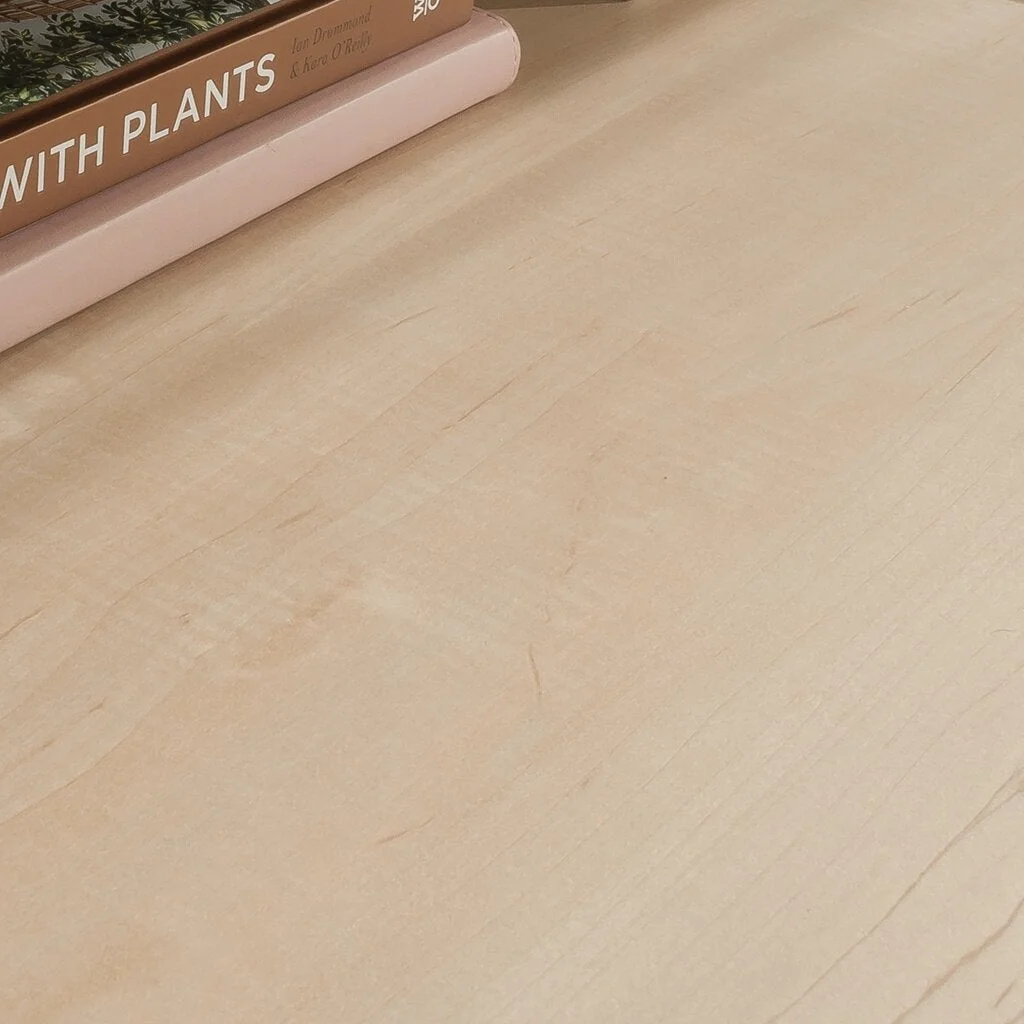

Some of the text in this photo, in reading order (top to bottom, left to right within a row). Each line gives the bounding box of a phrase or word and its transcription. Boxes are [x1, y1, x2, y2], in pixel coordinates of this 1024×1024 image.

[291, 3, 373, 55] Ian Drummond
[289, 60, 298, 80] &
[121, 52, 277, 155] PLANTS
